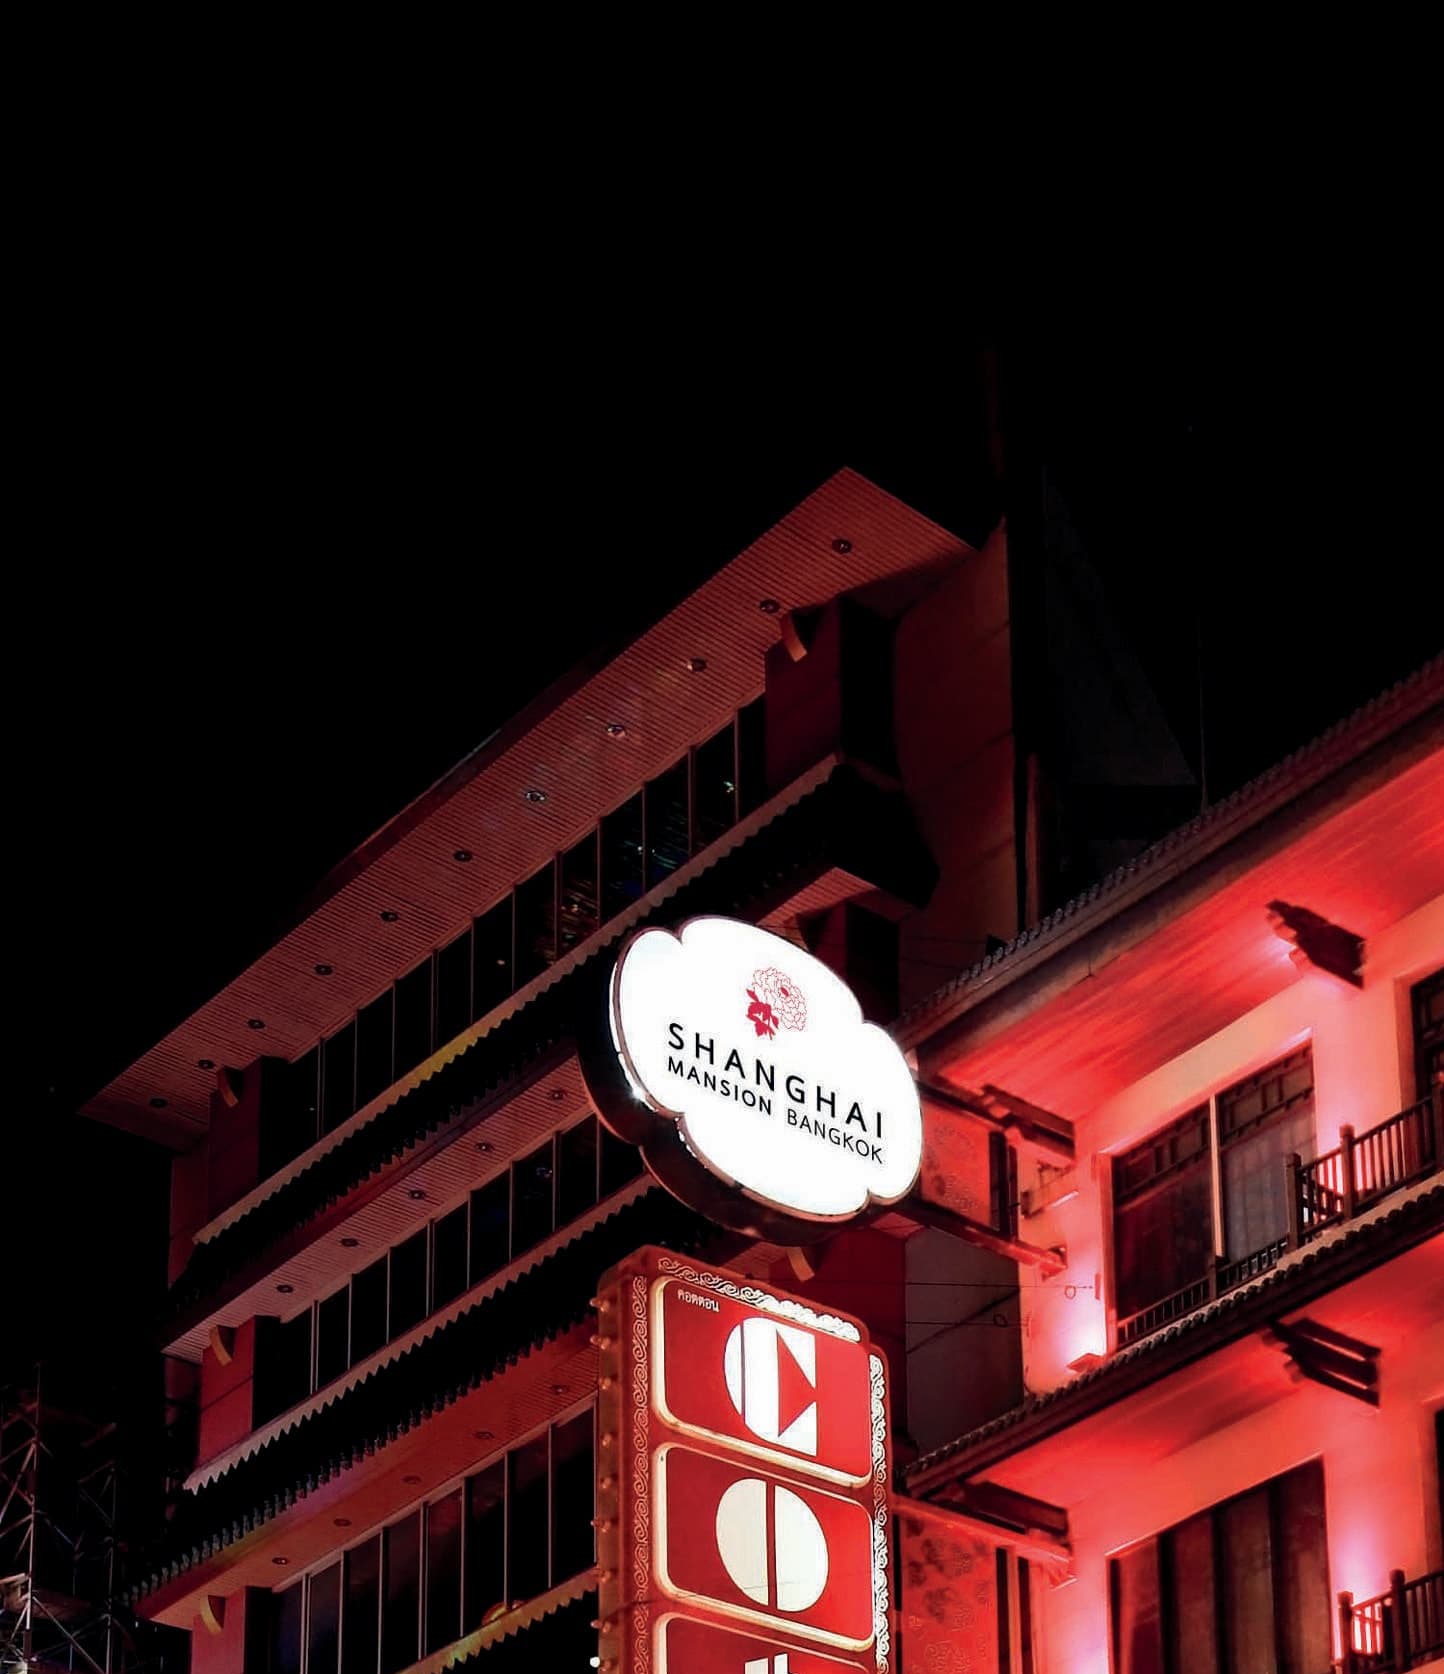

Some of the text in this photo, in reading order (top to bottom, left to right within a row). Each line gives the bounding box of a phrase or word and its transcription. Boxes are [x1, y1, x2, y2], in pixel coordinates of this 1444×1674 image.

[667, 1022, 882, 1138] SHANGHAI
[667, 1056, 883, 1165] MANSION BANGKOK
